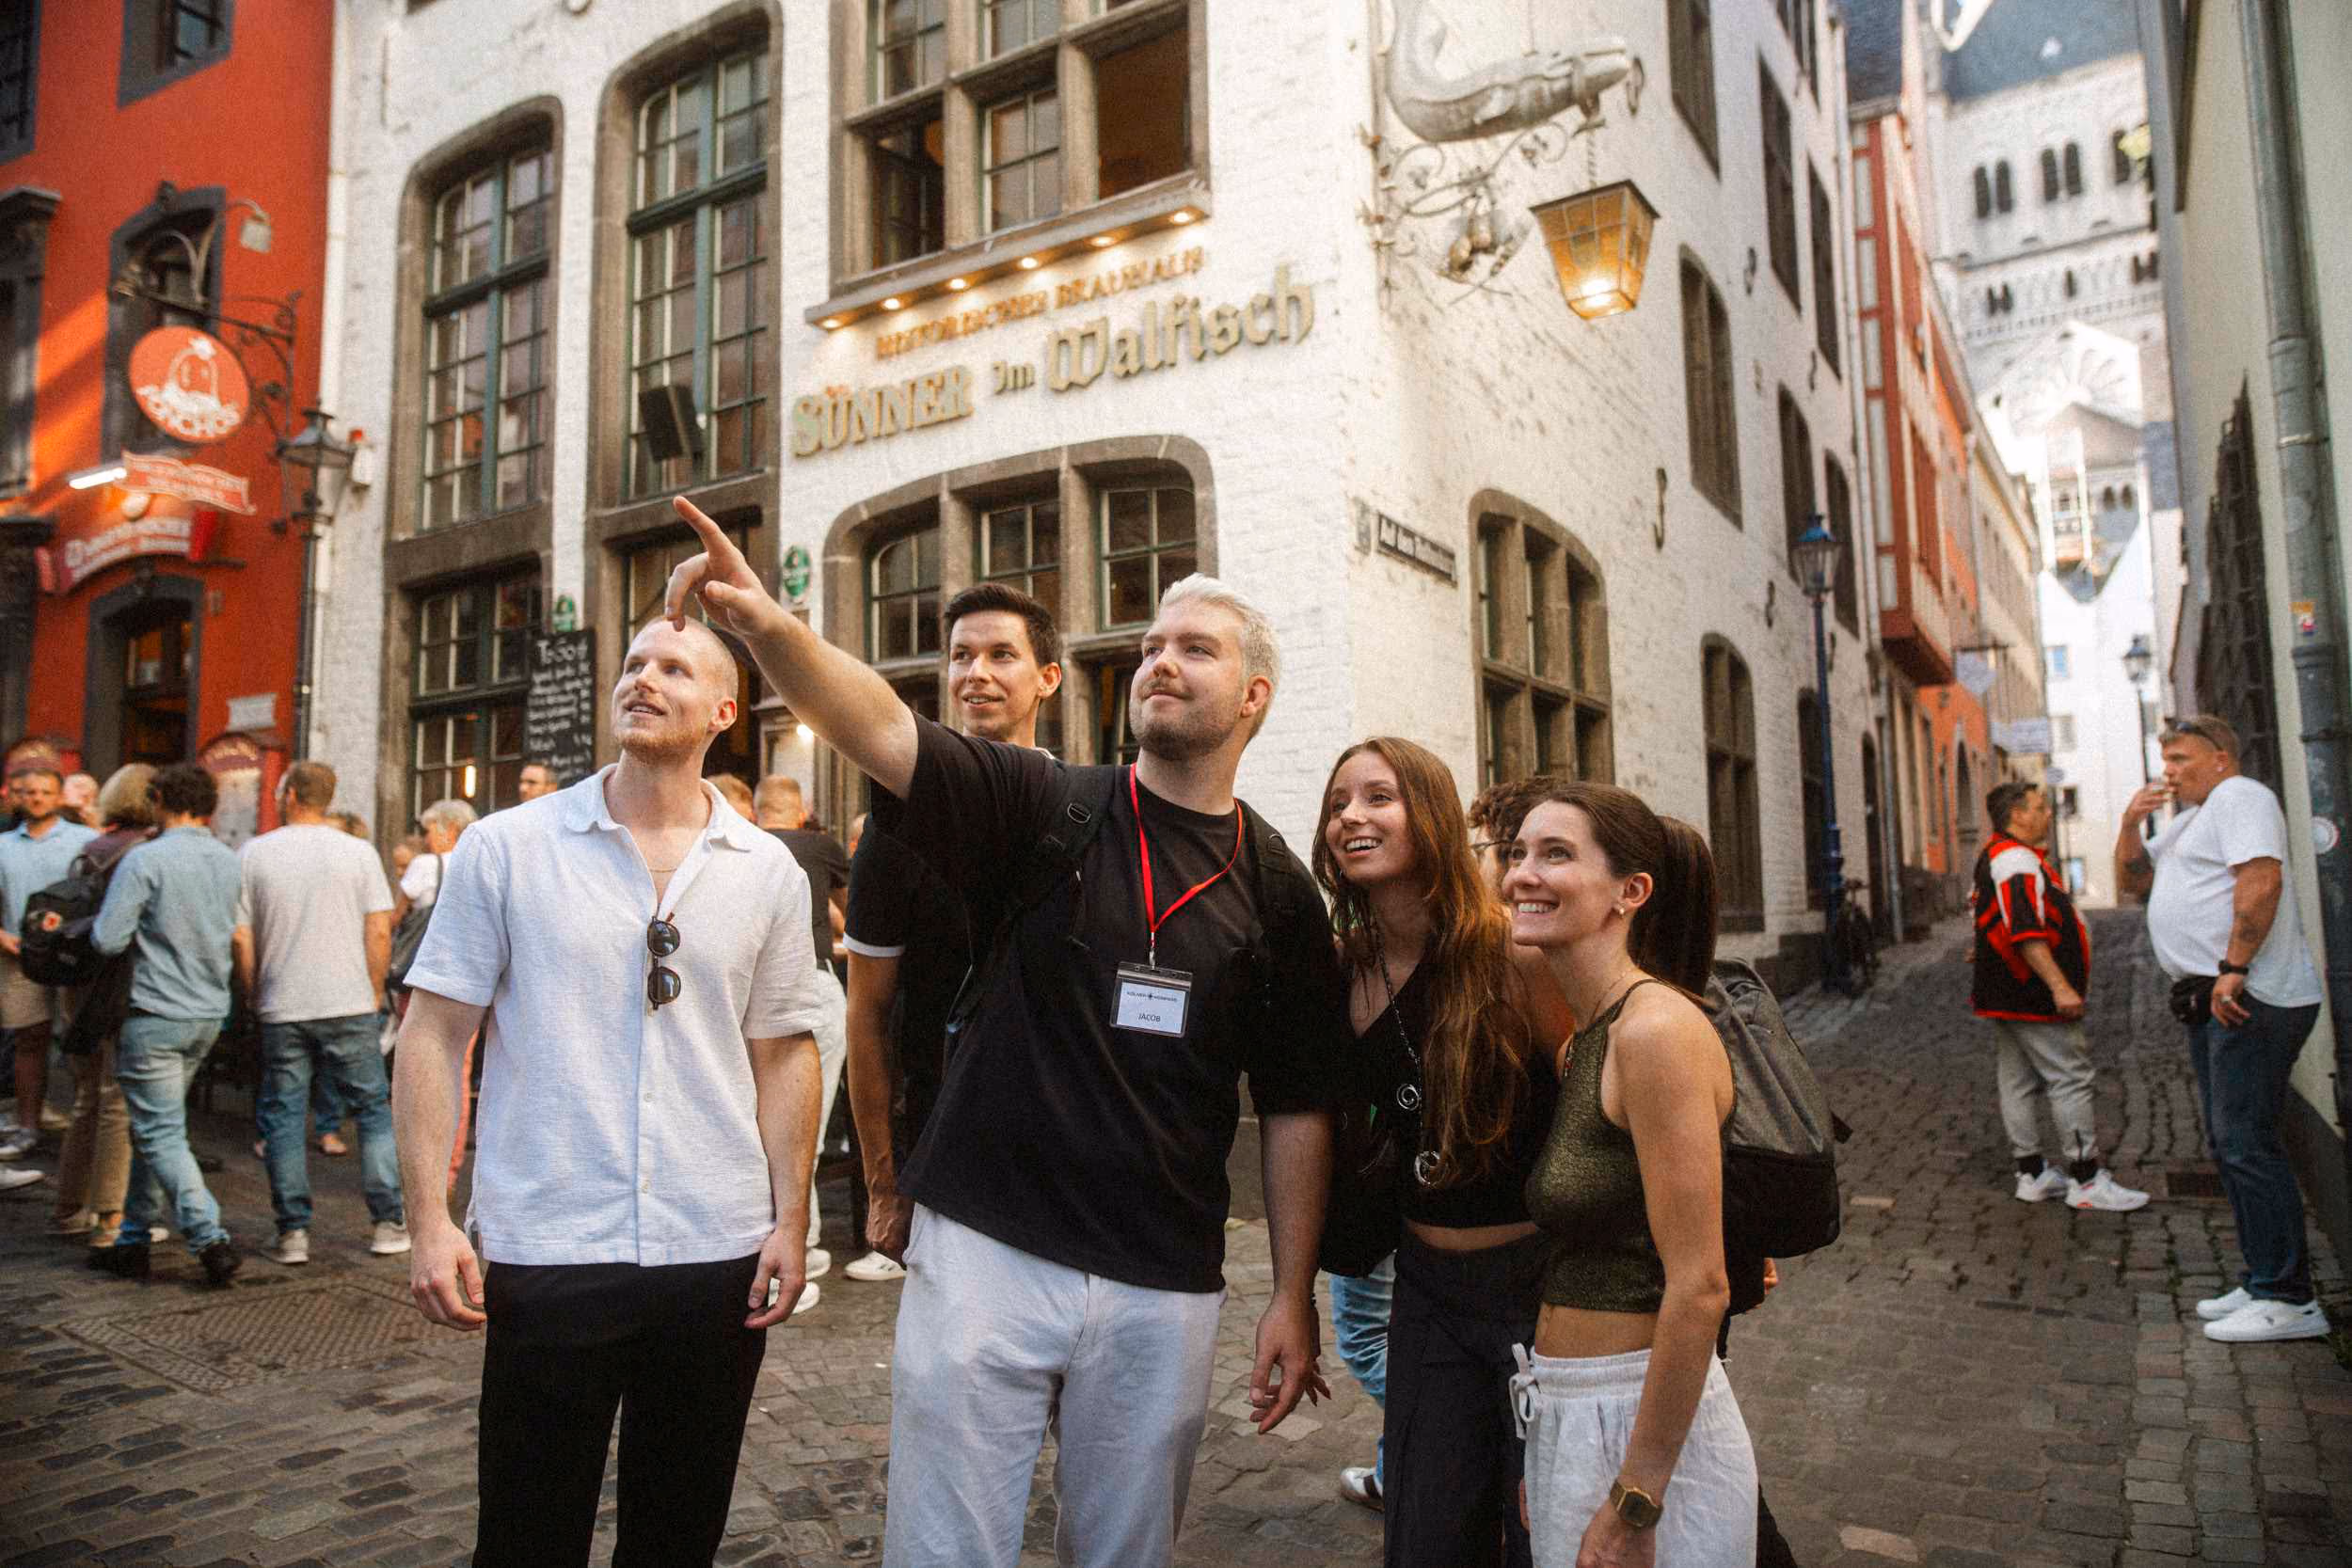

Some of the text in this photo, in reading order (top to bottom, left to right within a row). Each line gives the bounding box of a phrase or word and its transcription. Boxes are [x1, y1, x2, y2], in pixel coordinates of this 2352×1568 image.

[1055, 245, 1204, 309] BRAUHAUS
[792, 365, 975, 458] SÜNNER
[1046, 263, 1314, 392] Walfisch
[1137, 1012, 1161, 1022] JACOB
